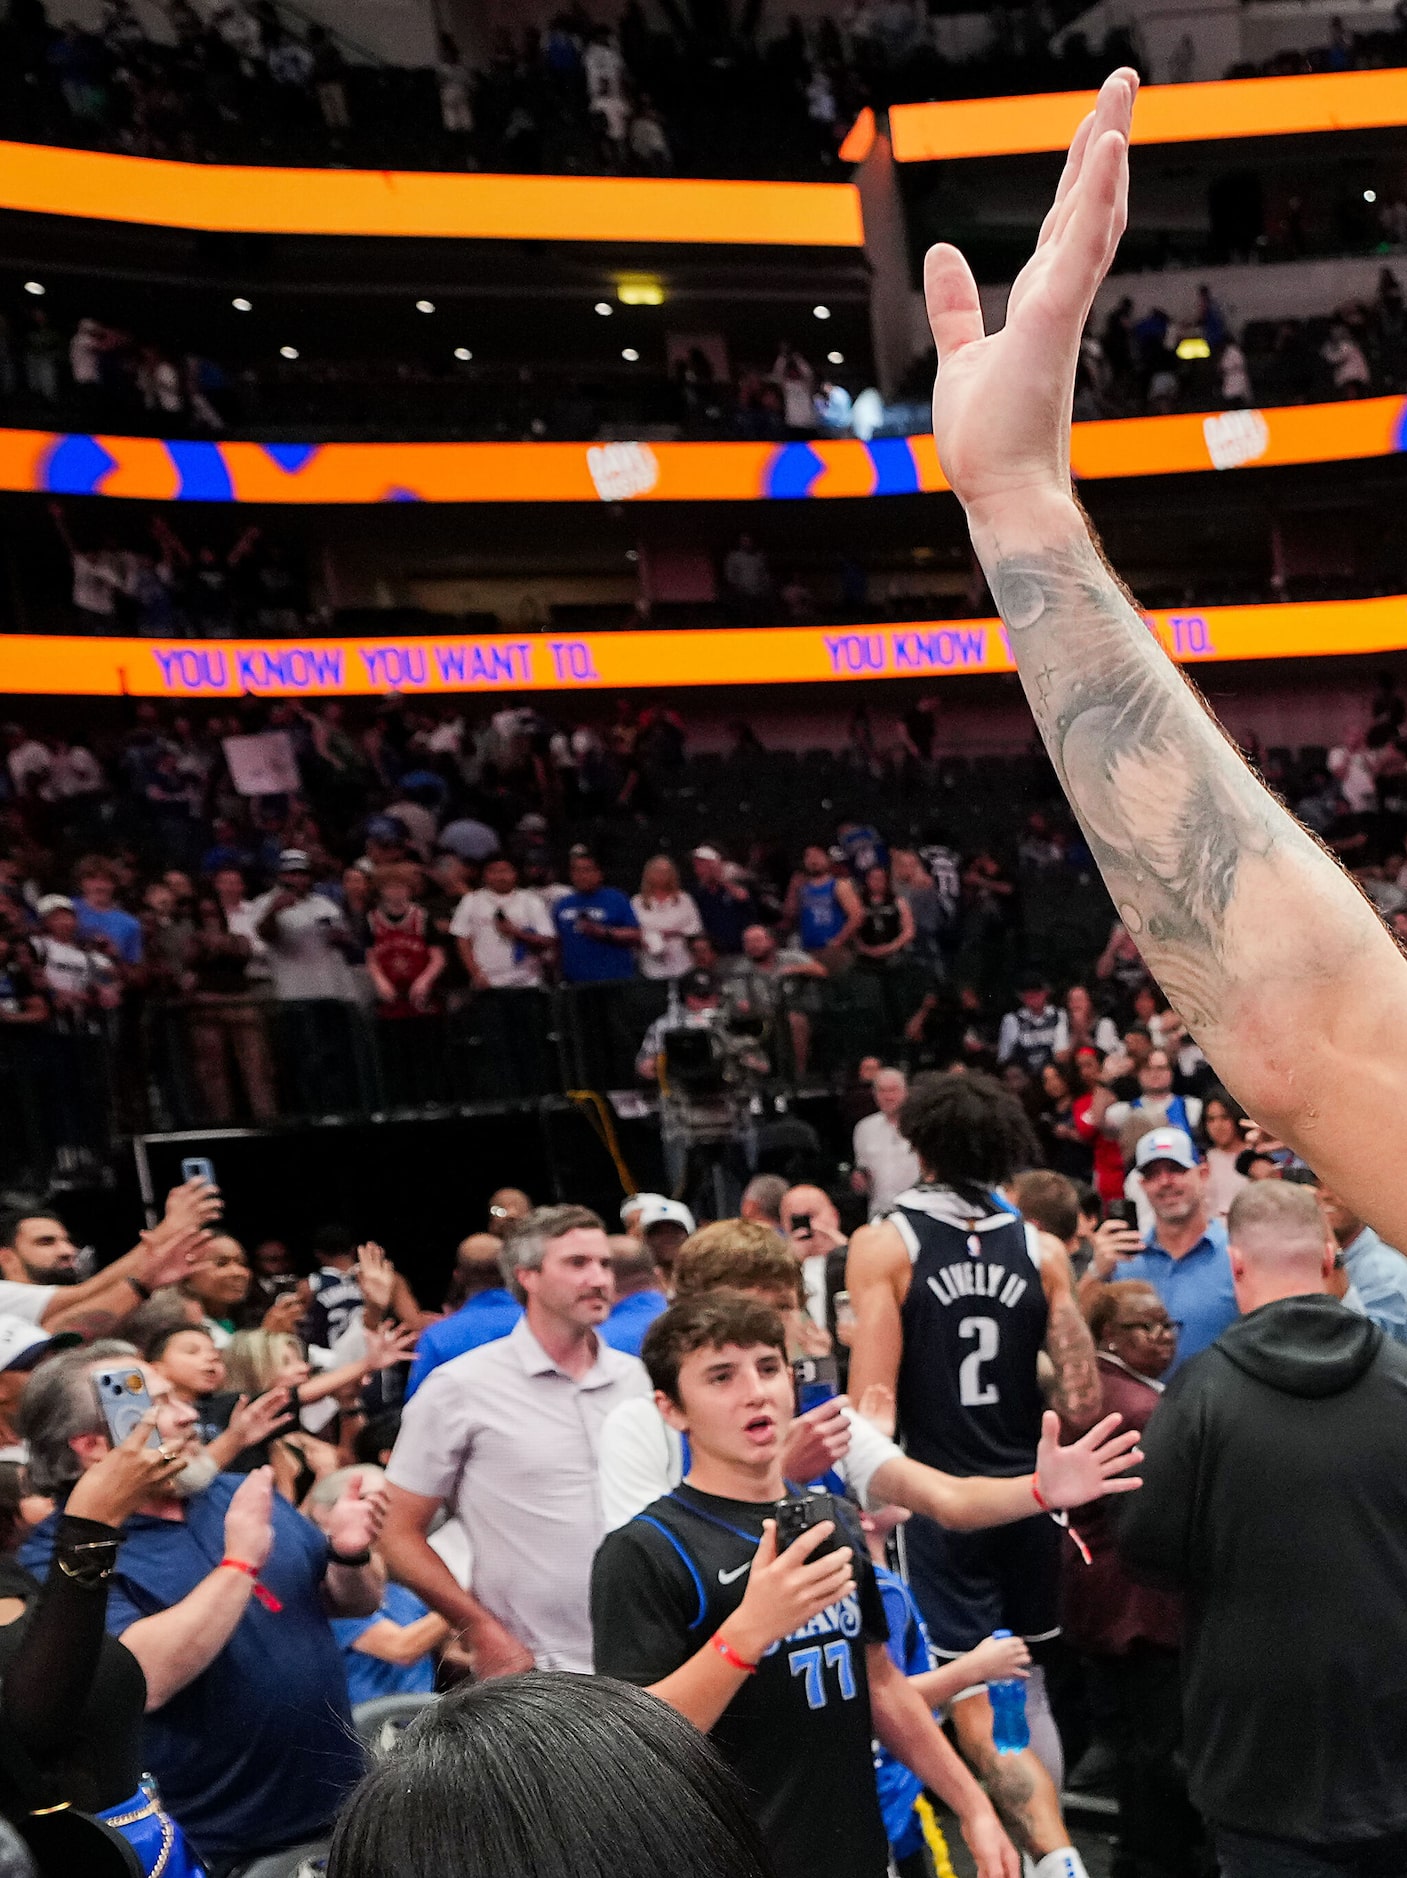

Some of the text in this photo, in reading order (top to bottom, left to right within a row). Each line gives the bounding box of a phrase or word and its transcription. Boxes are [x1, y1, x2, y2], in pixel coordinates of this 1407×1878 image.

[823, 635, 884, 671] YOU
[892, 628, 984, 666] KNOW
[1170, 618, 1215, 652] TO.
[153, 643, 599, 687] YOU KNOW YOU WANT TO.
[926, 1261, 1028, 1308] LIVELY II
[958, 1316, 1000, 1406] 2
[788, 1638, 858, 1711] 77
